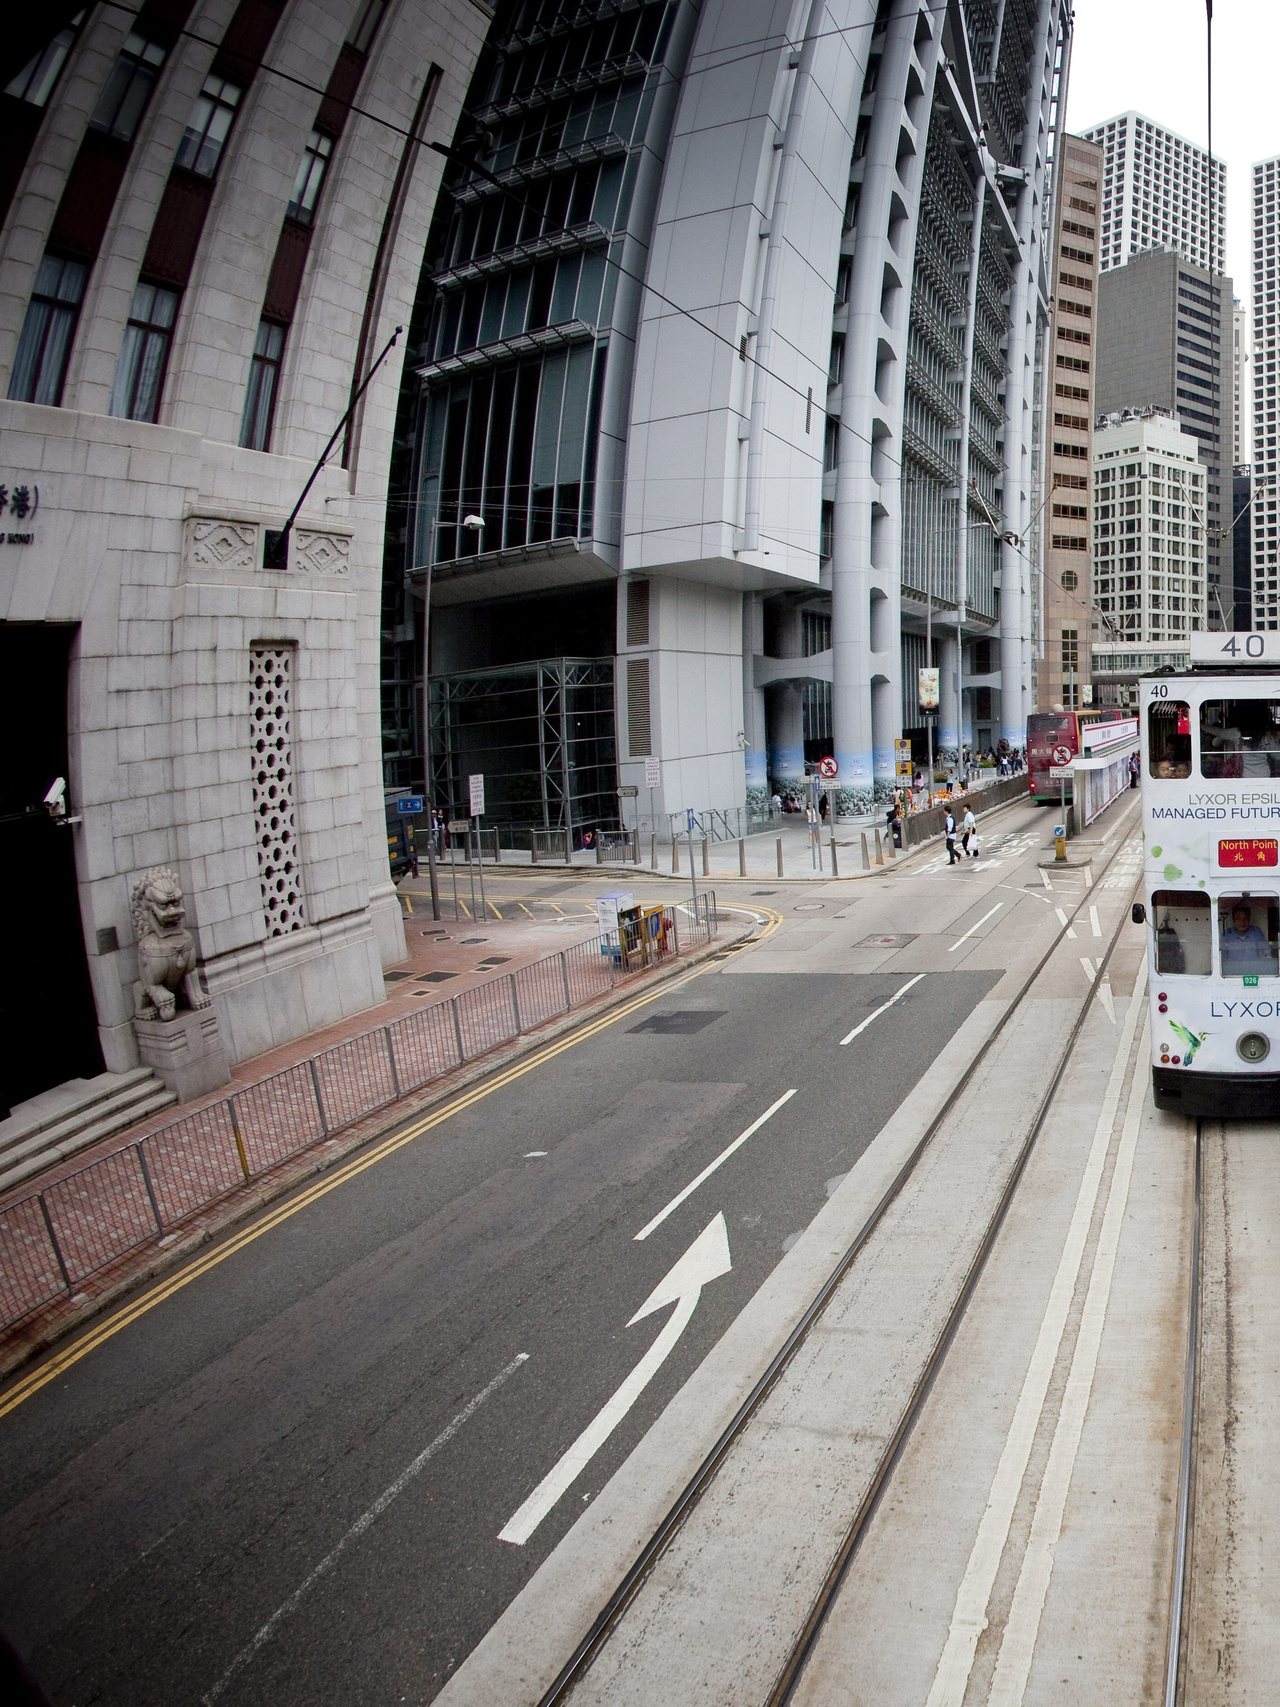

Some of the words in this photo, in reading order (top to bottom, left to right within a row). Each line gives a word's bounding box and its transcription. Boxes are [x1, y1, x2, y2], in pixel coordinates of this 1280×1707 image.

[1220, 635, 1264, 657] 40
[1150, 685, 1168, 698] 40
[1188, 794, 1237, 805] LYXOR
[1152, 807, 1227, 819] MANAGED
[1221, 840, 1249, 850] North
[1252, 839, 1278, 849] Point
